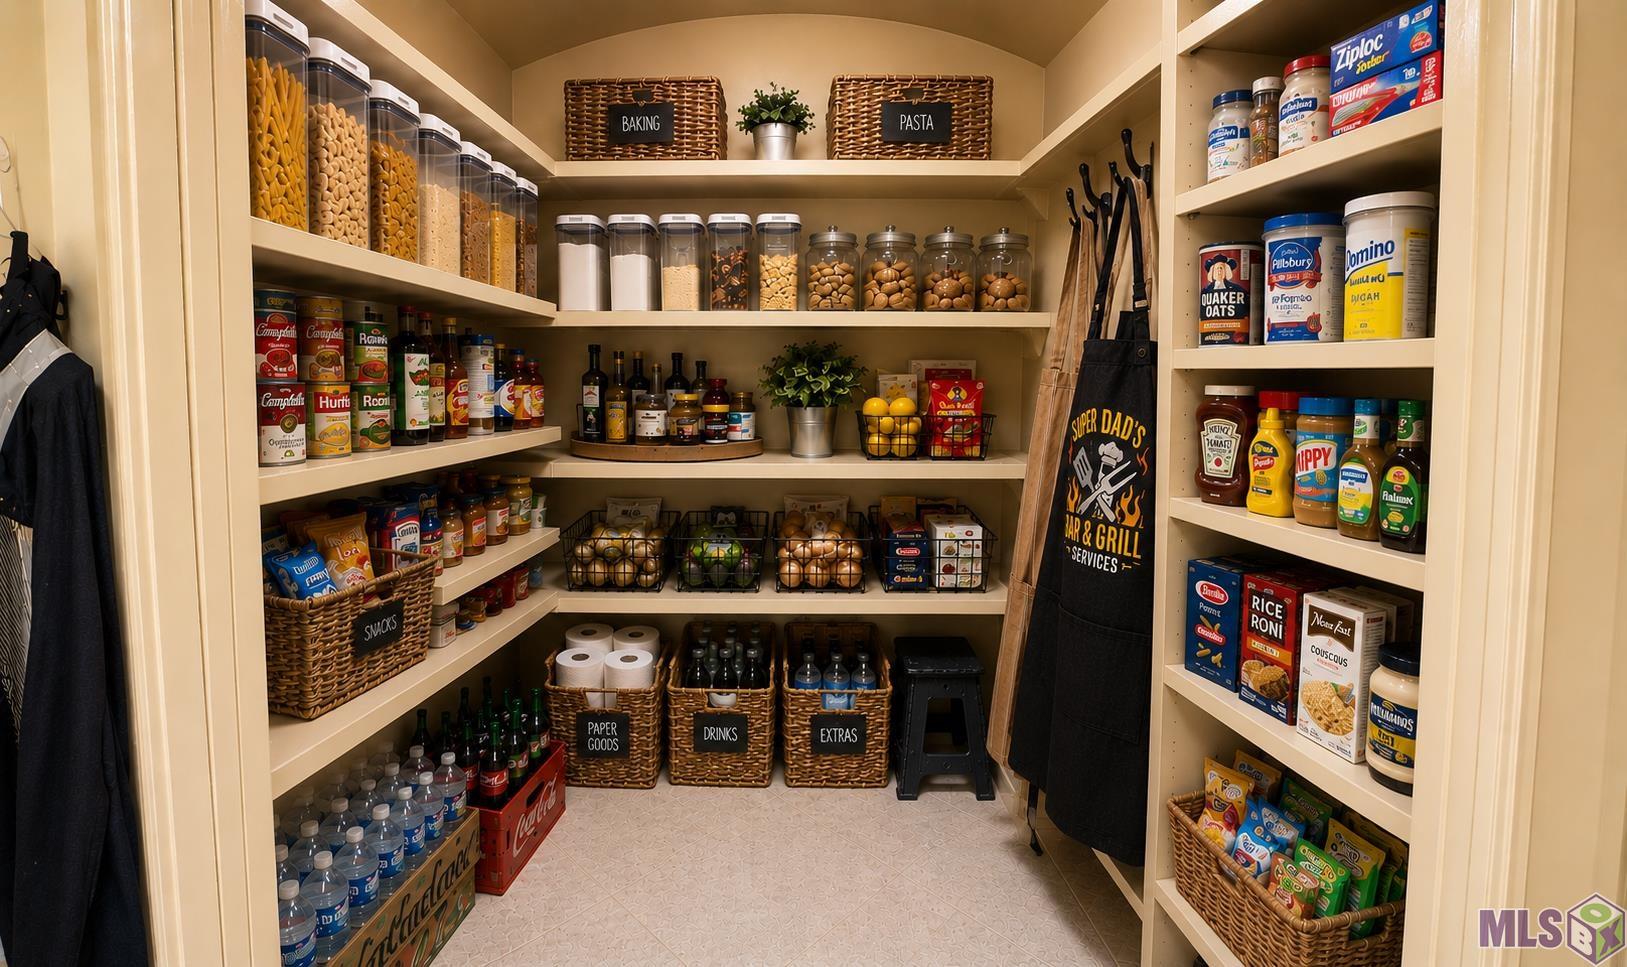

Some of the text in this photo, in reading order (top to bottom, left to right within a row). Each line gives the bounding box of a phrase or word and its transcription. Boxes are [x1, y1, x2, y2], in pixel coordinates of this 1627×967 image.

[1334, 33, 1384, 73] Ziploc
[621, 114, 661, 133] BAKING
[899, 113, 935, 132] PASTA
[1201, 291, 1245, 306] QUAKER
[1205, 305, 1236, 318] OATS
[1071, 407, 1147, 449] SUPER DAD'S
[1082, 521, 1092, 547] &
[1095, 523, 1142, 559] GRILL
[1071, 545, 1118, 573] SERVICES
[1251, 594, 1284, 620] RICE
[363, 613, 398, 642] SNACKS
[1250, 613, 1284, 640] RONI
[587, 721, 618, 737] PAPER
[702, 725, 738, 742] DRINKS
[820, 726, 859, 744] EXTRAS
[587, 736, 620, 752] GOODS
